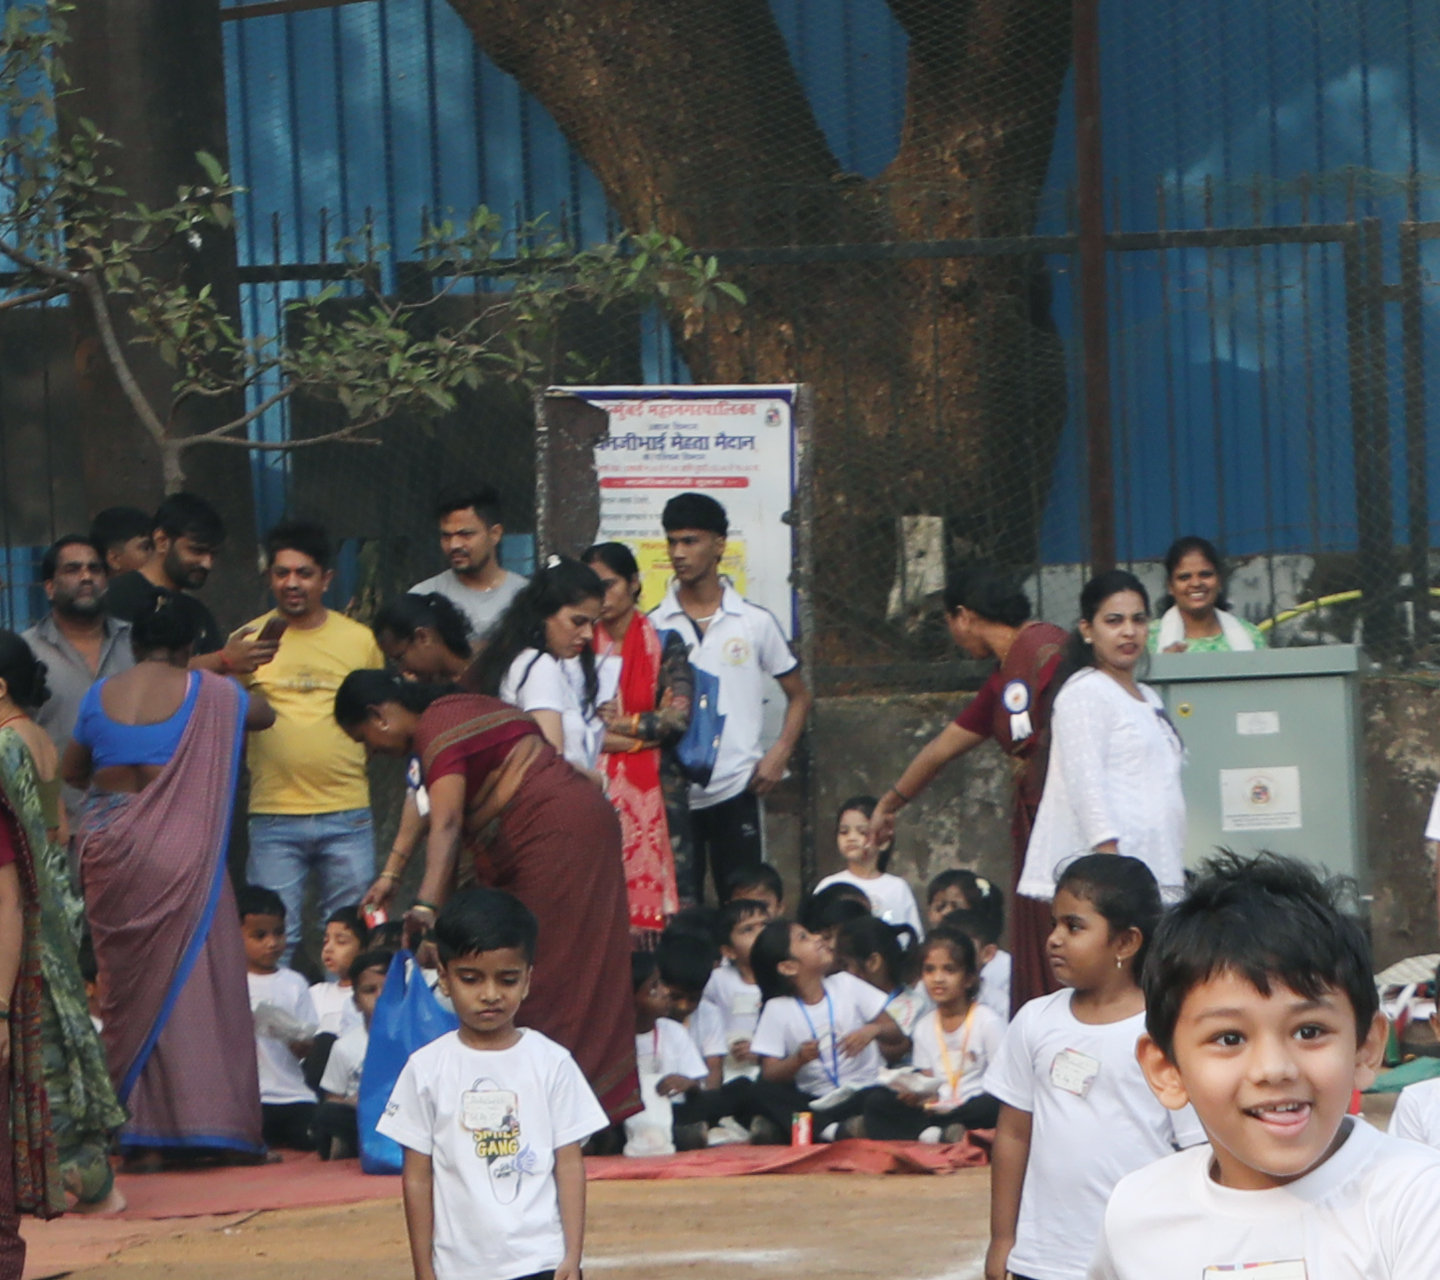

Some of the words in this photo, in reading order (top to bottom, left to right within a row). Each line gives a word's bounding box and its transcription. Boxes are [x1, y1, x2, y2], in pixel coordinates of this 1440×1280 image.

[670, 432, 709, 450] मेहता
[714, 431, 755, 450] मैदान
[476, 1138, 519, 1157] GANG
